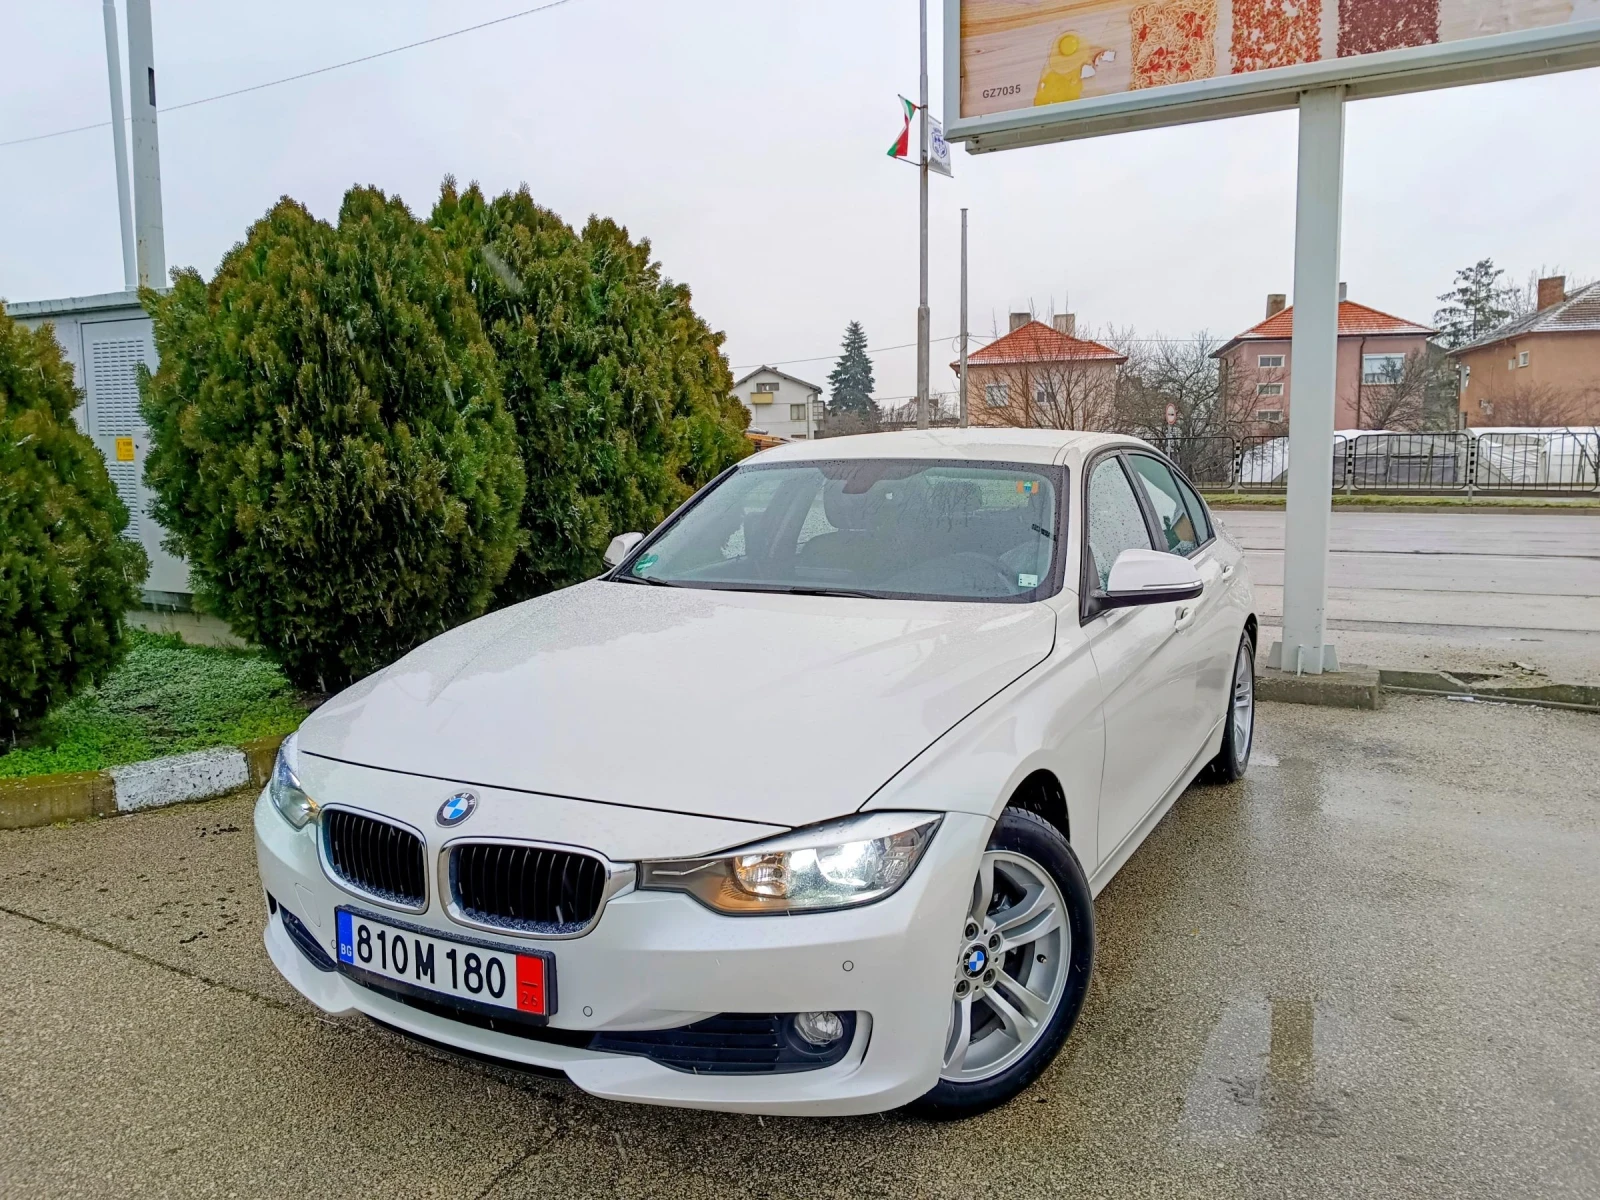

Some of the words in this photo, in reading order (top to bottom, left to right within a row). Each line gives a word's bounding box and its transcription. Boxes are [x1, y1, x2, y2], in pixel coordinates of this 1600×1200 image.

[982, 84, 1021, 99] GZ7035
[340, 943, 352, 957] BG
[521, 990, 538, 1007] 26
